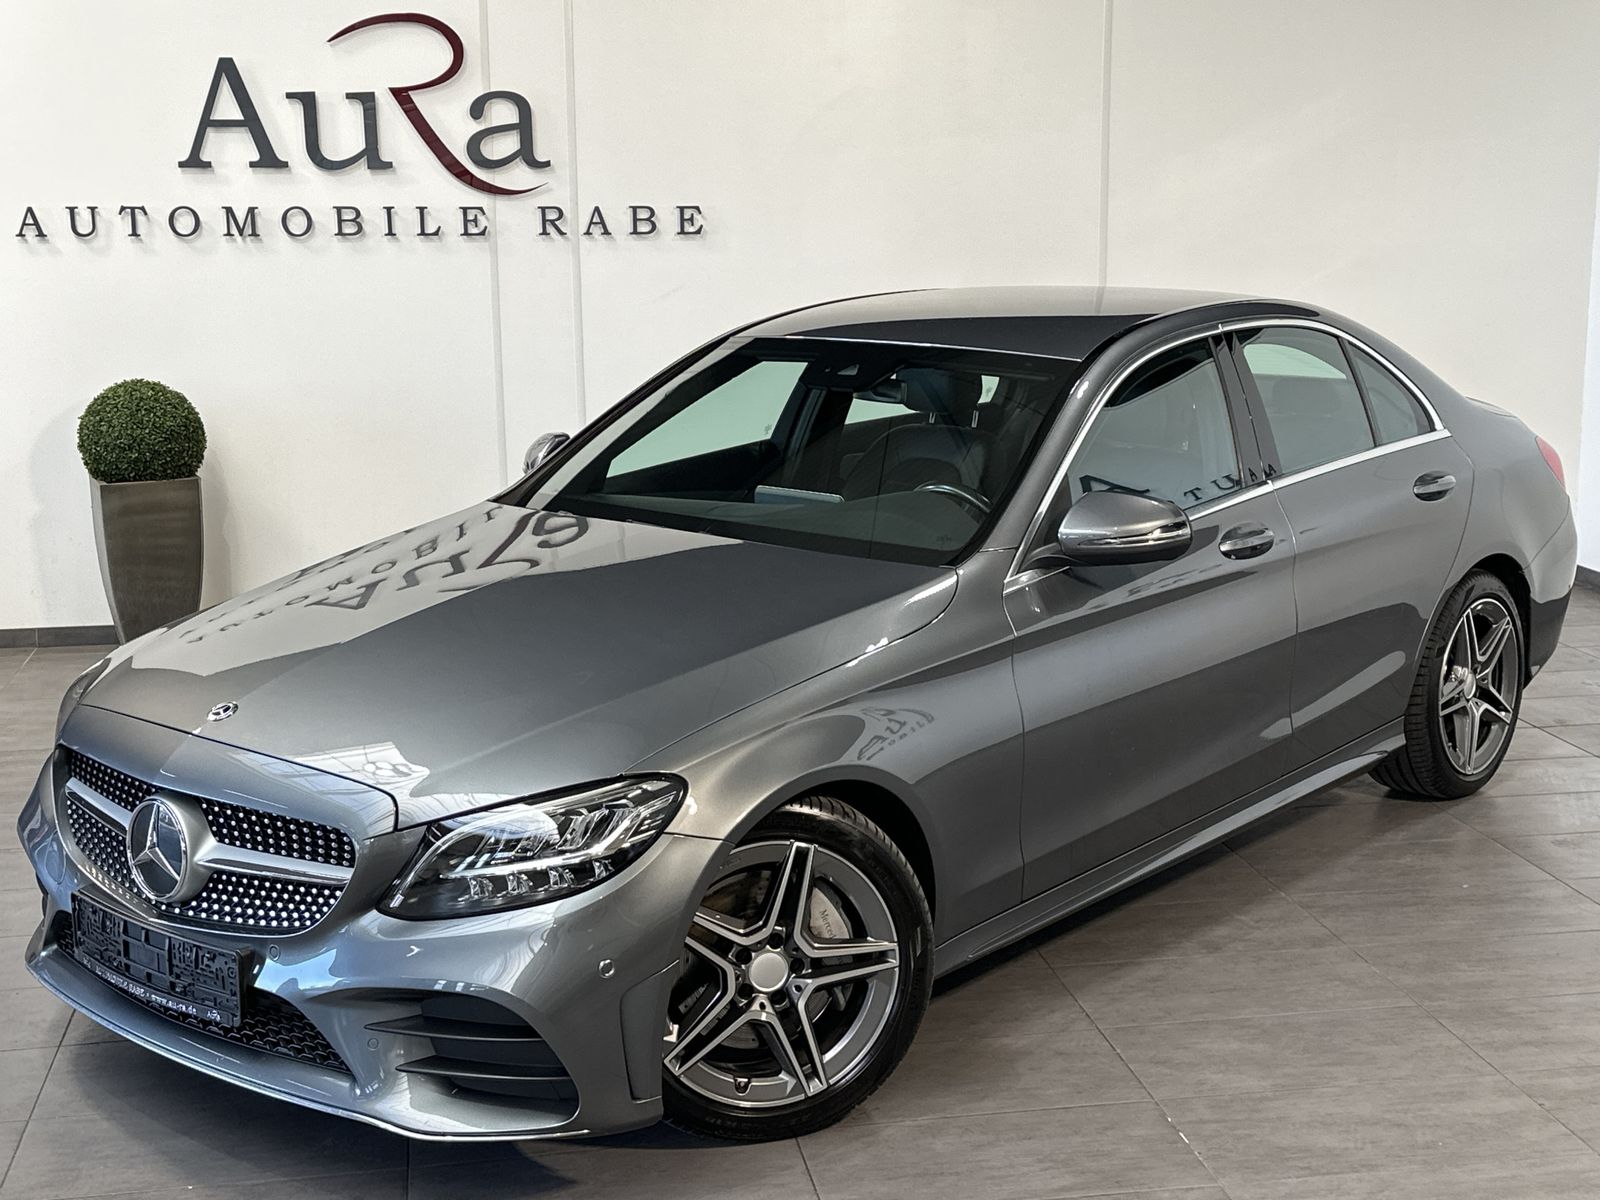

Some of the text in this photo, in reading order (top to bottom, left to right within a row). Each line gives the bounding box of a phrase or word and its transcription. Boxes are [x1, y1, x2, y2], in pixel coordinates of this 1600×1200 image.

[177, 12, 551, 196] AuRa
[16, 204, 705, 239] AUTOMOBILE RABE
